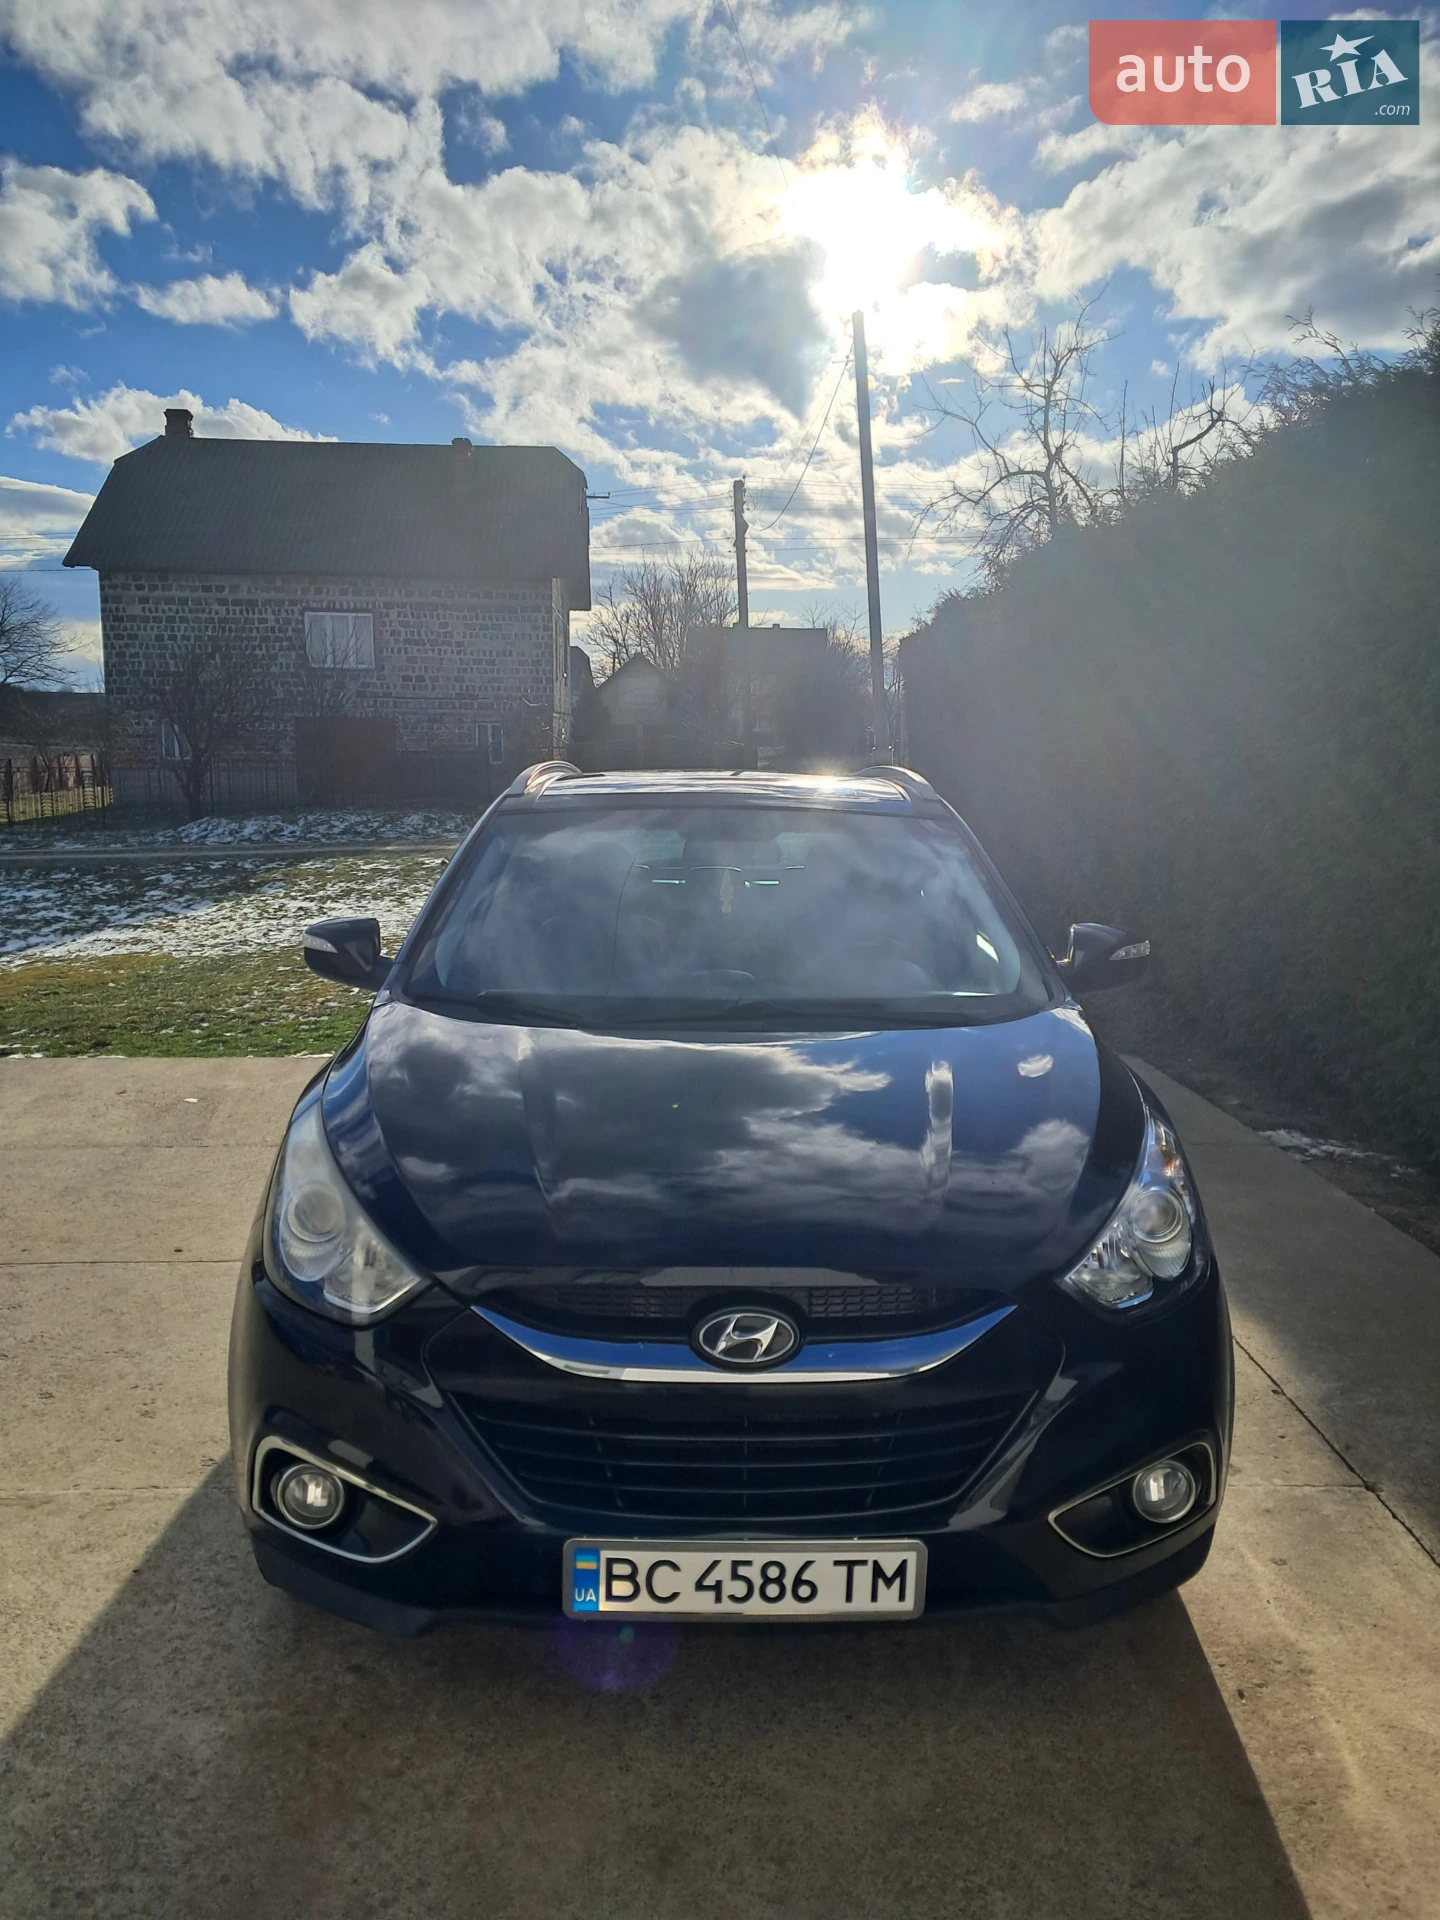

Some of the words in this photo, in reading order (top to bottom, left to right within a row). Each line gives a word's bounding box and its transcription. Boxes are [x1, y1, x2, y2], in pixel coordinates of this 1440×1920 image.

[575, 1588, 597, 1602] UA
[604, 1557, 682, 1604] BC
[694, 1559, 819, 1604] 4586
[833, 1558, 908, 1603] TM
